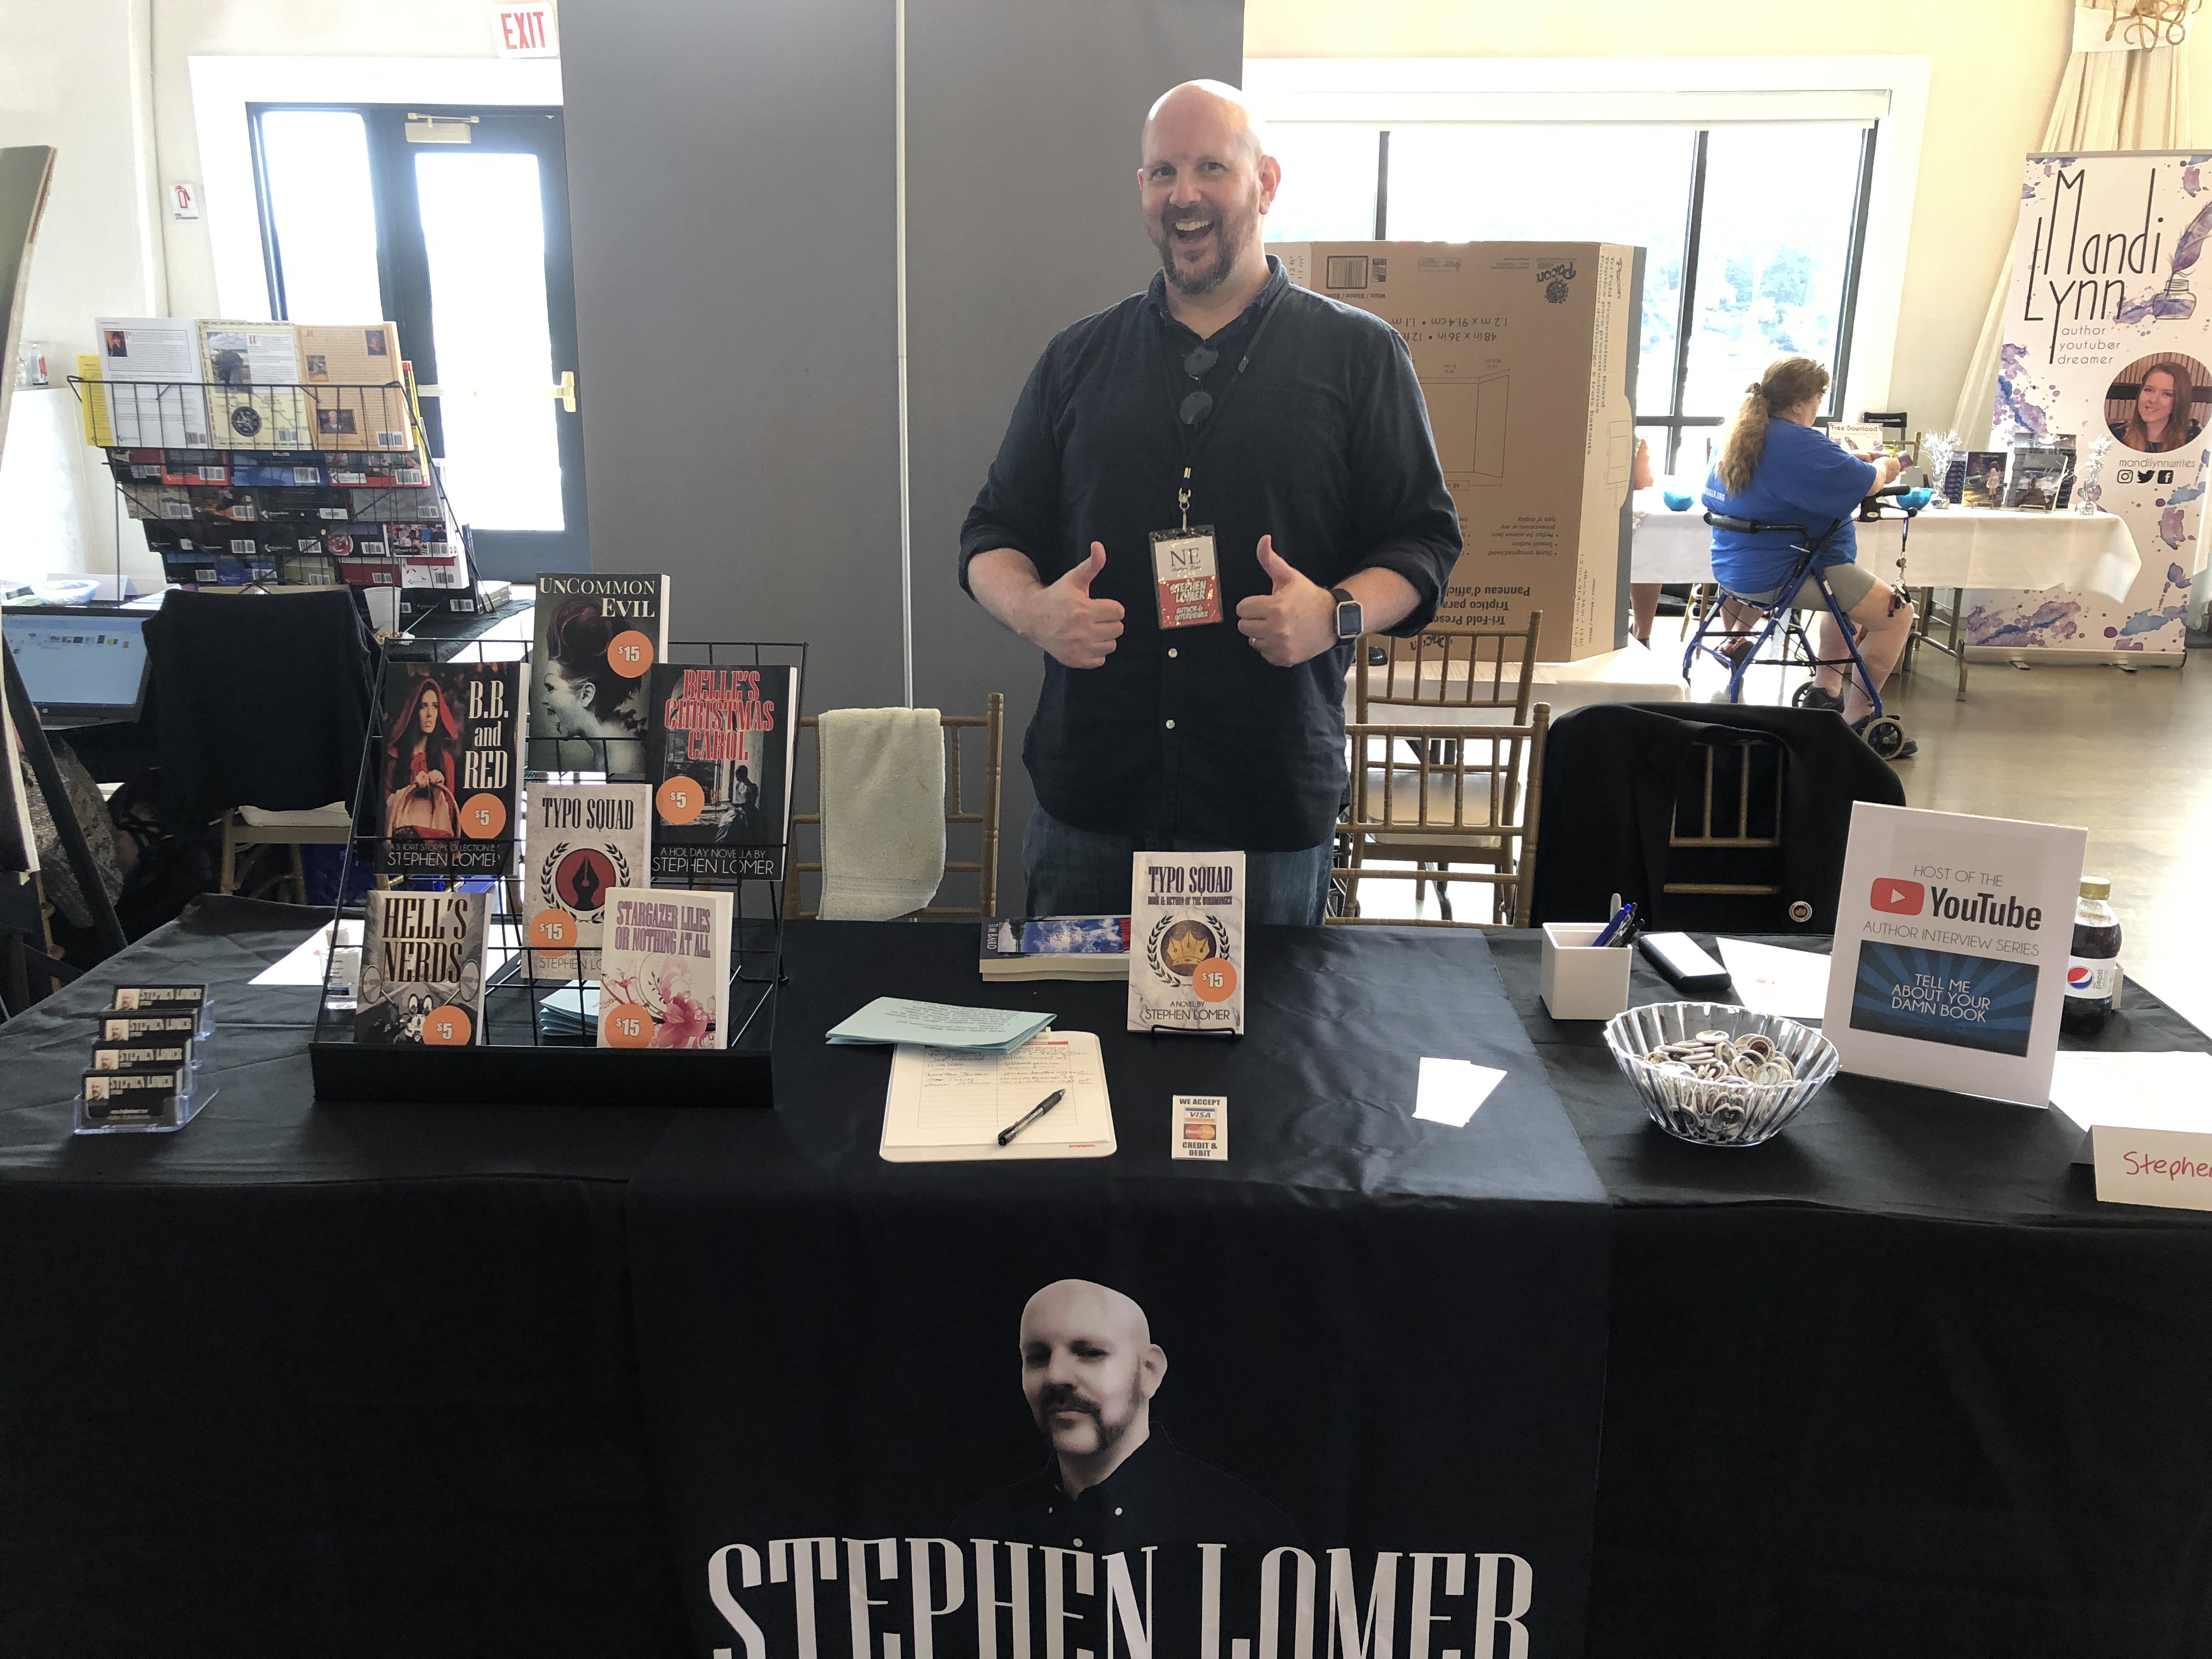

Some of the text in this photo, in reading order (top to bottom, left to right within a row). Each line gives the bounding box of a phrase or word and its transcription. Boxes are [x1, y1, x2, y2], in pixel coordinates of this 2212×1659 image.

[501, 12, 546, 49] EXIT
[2044, 168, 2164, 275] Mandi
[1536, 262, 1578, 283] Pacon
[2024, 217, 2125, 364] Lynn
[1494, 318, 1508, 327] 1.2
[2061, 325, 2106, 336] author
[1603, 301, 1611, 371] Presentation
[2059, 340, 2121, 352] youtuber
[2057, 354, 2113, 365] dreamer
[2119, 457, 2196, 470] mandilynnwrites
[1169, 548, 1201, 567] NE
[540, 578, 655, 595] UNCOMMON
[1169, 580, 1207, 594] STEPHEN
[1175, 590, 1206, 603] LOMER
[1484, 586, 1531, 596] Panneau
[601, 597, 655, 617] EVIL
[1443, 599, 1466, 608] para
[1174, 611, 1209, 622] INTERVIEWER
[1466, 615, 1506, 625] Tri-Fold
[618, 645, 640, 662] $15
[682, 669, 760, 702] BELLE'S
[469, 680, 509, 719] B.B.
[664, 698, 775, 732] CHRISTMAS
[474, 721, 502, 747] and
[687, 730, 749, 761] CAROL
[463, 750, 508, 789] RED
[670, 792, 687, 809] $5
[475, 810, 490, 826] $5
[542, 798, 634, 833] TYPO SQUAD
[387, 852, 448, 866] STEPHEN
[660, 847, 667, 856] A
[669, 847, 709, 857] HOLDAY
[754, 850, 766, 859] BY
[652, 856, 774, 875] STEPHEN LOMER
[1148, 866, 1233, 896] TYPO SQUAD
[1914, 865, 2004, 888] HOST OF THE
[382, 898, 469, 939] HELL'S
[616, 900, 711, 933] STARGAZER LILIES
[1931, 886, 2042, 931] YouTube
[539, 922, 563, 940] $15
[987, 923, 999, 950] TIM BAIRD
[1863, 921, 2040, 956] AUTHOR INTERVIEW SERIES
[614, 926, 711, 958] OR NOTHING AT ALL
[382, 941, 462, 983] NERDS
[539, 957, 588, 970] STEPHEN
[1202, 972, 1223, 988] $15
[1915, 973, 1971, 994] TELL ME
[1892, 984, 1991, 1010] ABOUT YOUR
[1145, 1009, 1230, 1020] STEPHEN LOMER
[1892, 996, 1987, 1023] DAMN BOOK
[437, 1022, 453, 1040] $5
[616, 1017, 640, 1037] $15
[707, 1537, 1534, 1659] STEPHEN LOMER
